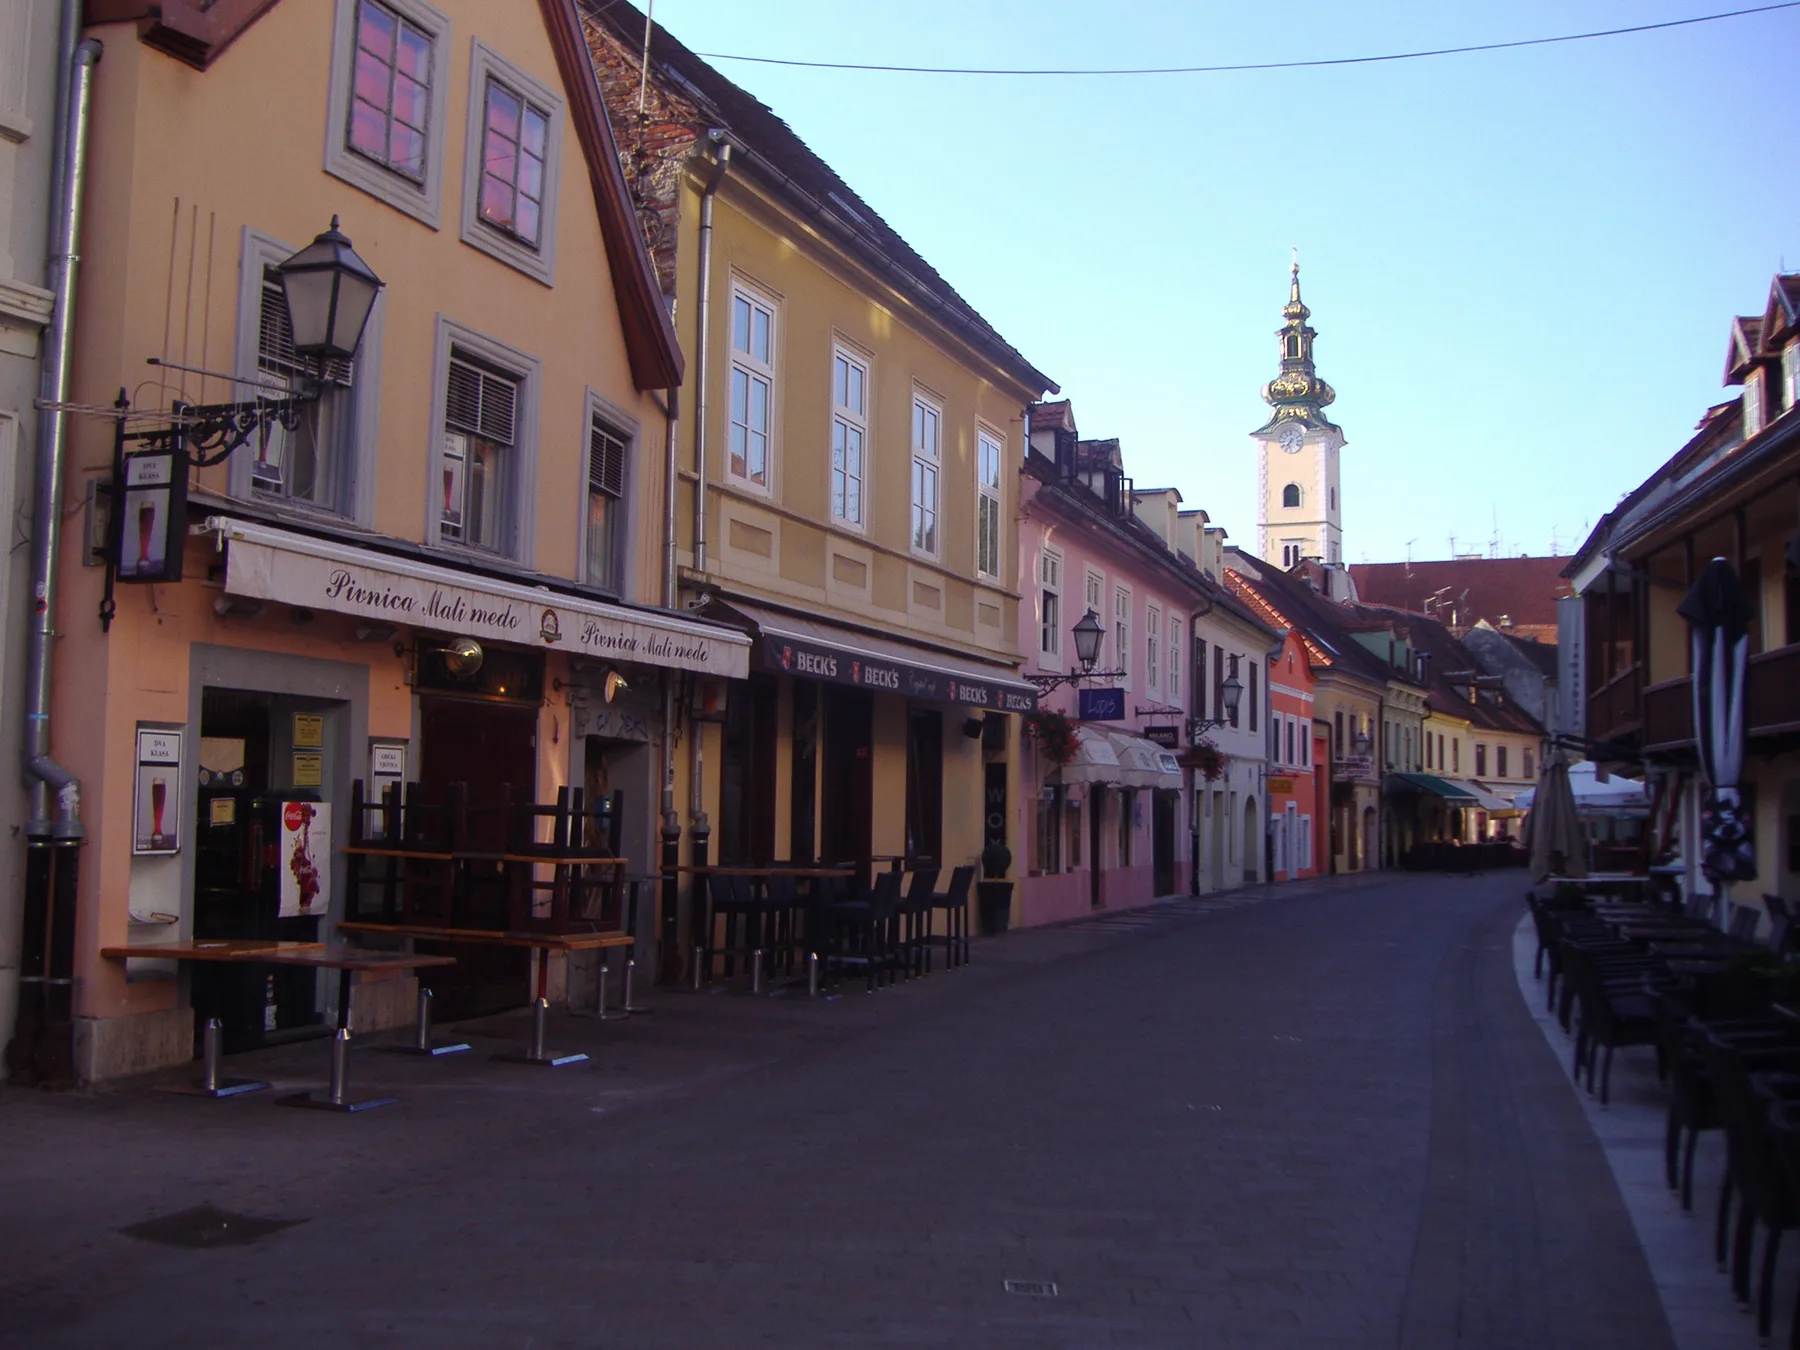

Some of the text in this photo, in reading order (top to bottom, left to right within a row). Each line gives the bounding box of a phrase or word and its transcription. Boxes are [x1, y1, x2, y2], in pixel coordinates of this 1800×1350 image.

[326, 569, 521, 629] Pivnica Mali medo
[581, 620, 640, 652] Pivnica
[642, 633, 673, 658] Mali
[674, 641, 708, 662] medo
[796, 652, 837, 677] BECK'S
[864, 665, 899, 689] BECK'S
[959, 684, 988, 704] BECK'S
[150, 749, 169, 757] KLASA
[154, 740, 166, 748] DVA
